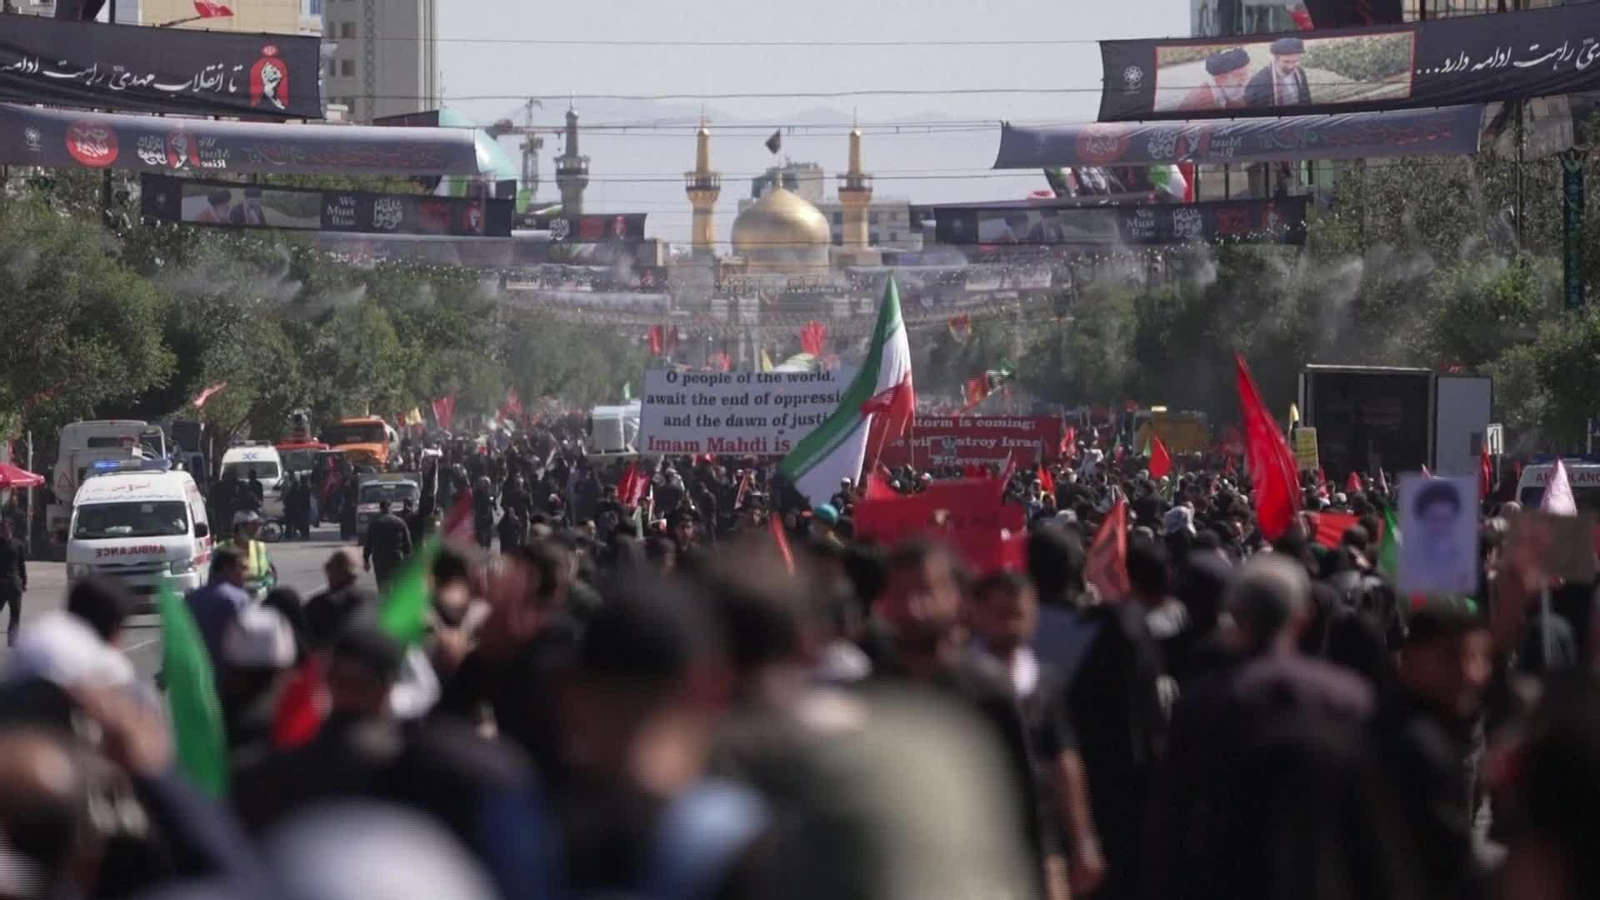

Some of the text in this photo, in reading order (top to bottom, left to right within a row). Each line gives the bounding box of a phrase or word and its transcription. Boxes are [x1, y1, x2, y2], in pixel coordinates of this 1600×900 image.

[153, 62, 225, 98] انقلاب
[326, 204, 355, 216] Must
[1126, 218, 1155, 228] Must
[666, 370, 678, 383] O
[682, 372, 732, 387] people
[736, 371, 752, 384] of
[757, 371, 781, 383] the
[646, 389, 847, 408] await the end of oppressi
[663, 412, 828, 429] and the dawn of justi
[912, 416, 954, 428] torm
[958, 416, 973, 428] is
[647, 434, 791, 453] Imam Mahdi is
[943, 437, 997, 449] stroy
[1002, 436, 1041, 448] Israe
